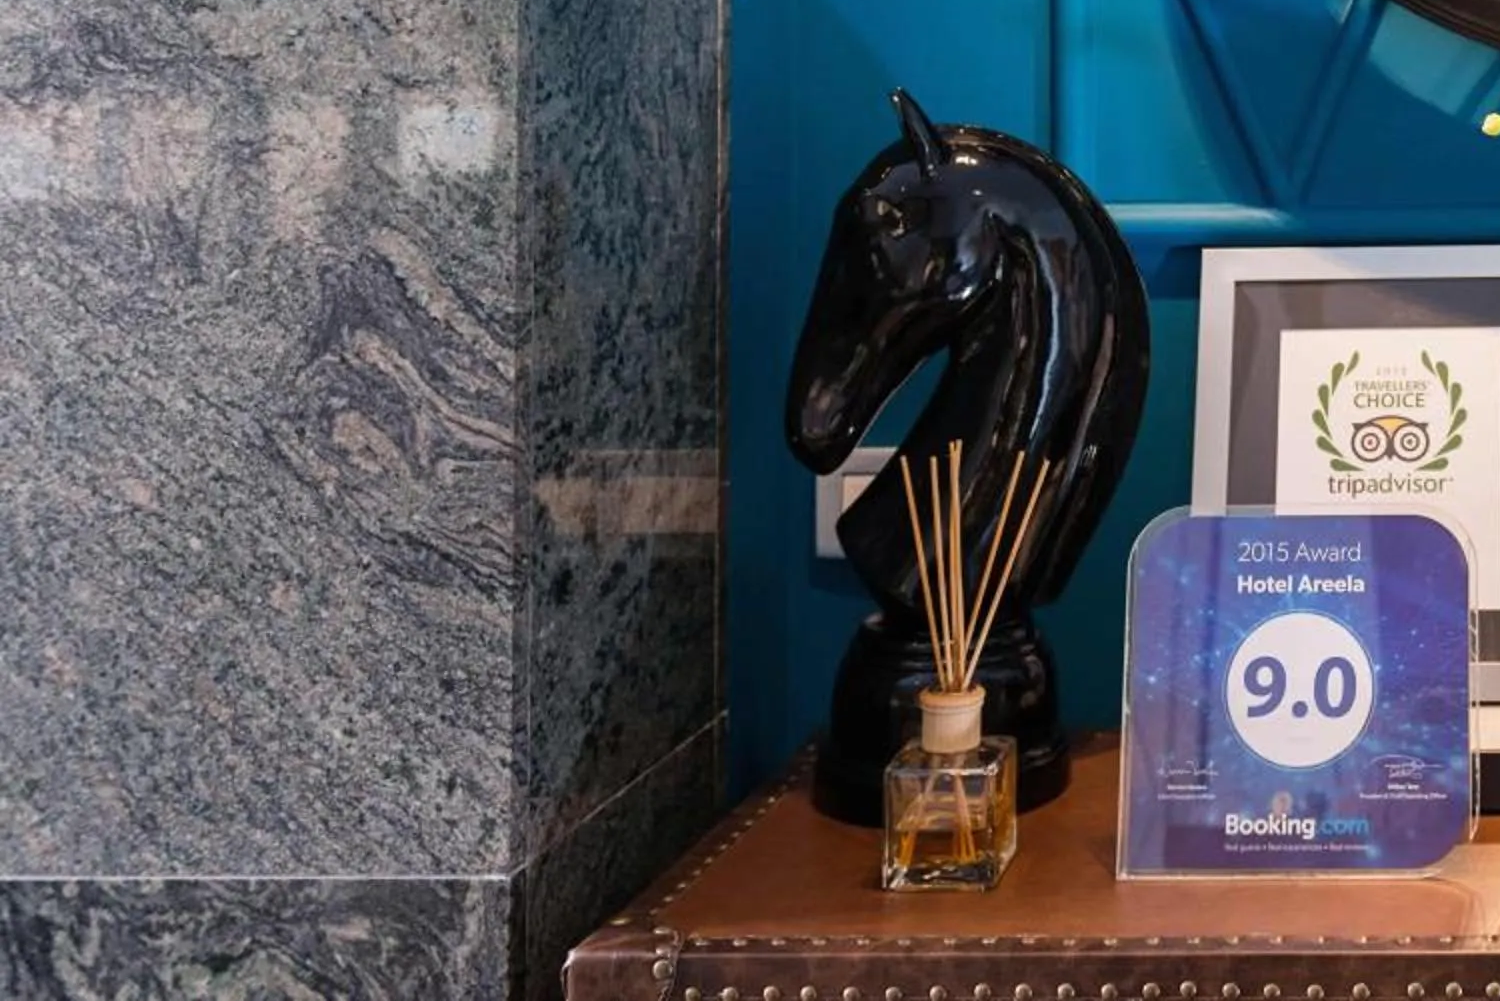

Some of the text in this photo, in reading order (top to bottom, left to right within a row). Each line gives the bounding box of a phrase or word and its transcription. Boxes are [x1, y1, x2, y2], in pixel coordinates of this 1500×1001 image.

[1353, 392, 1426, 409] CHOICE
[1327, 473, 1448, 499] tripadvisor
[1237, 541, 1362, 563] 2015 Award
[1237, 574, 1366, 594] Hotel Areela
[1243, 655, 1357, 719] 9.0
